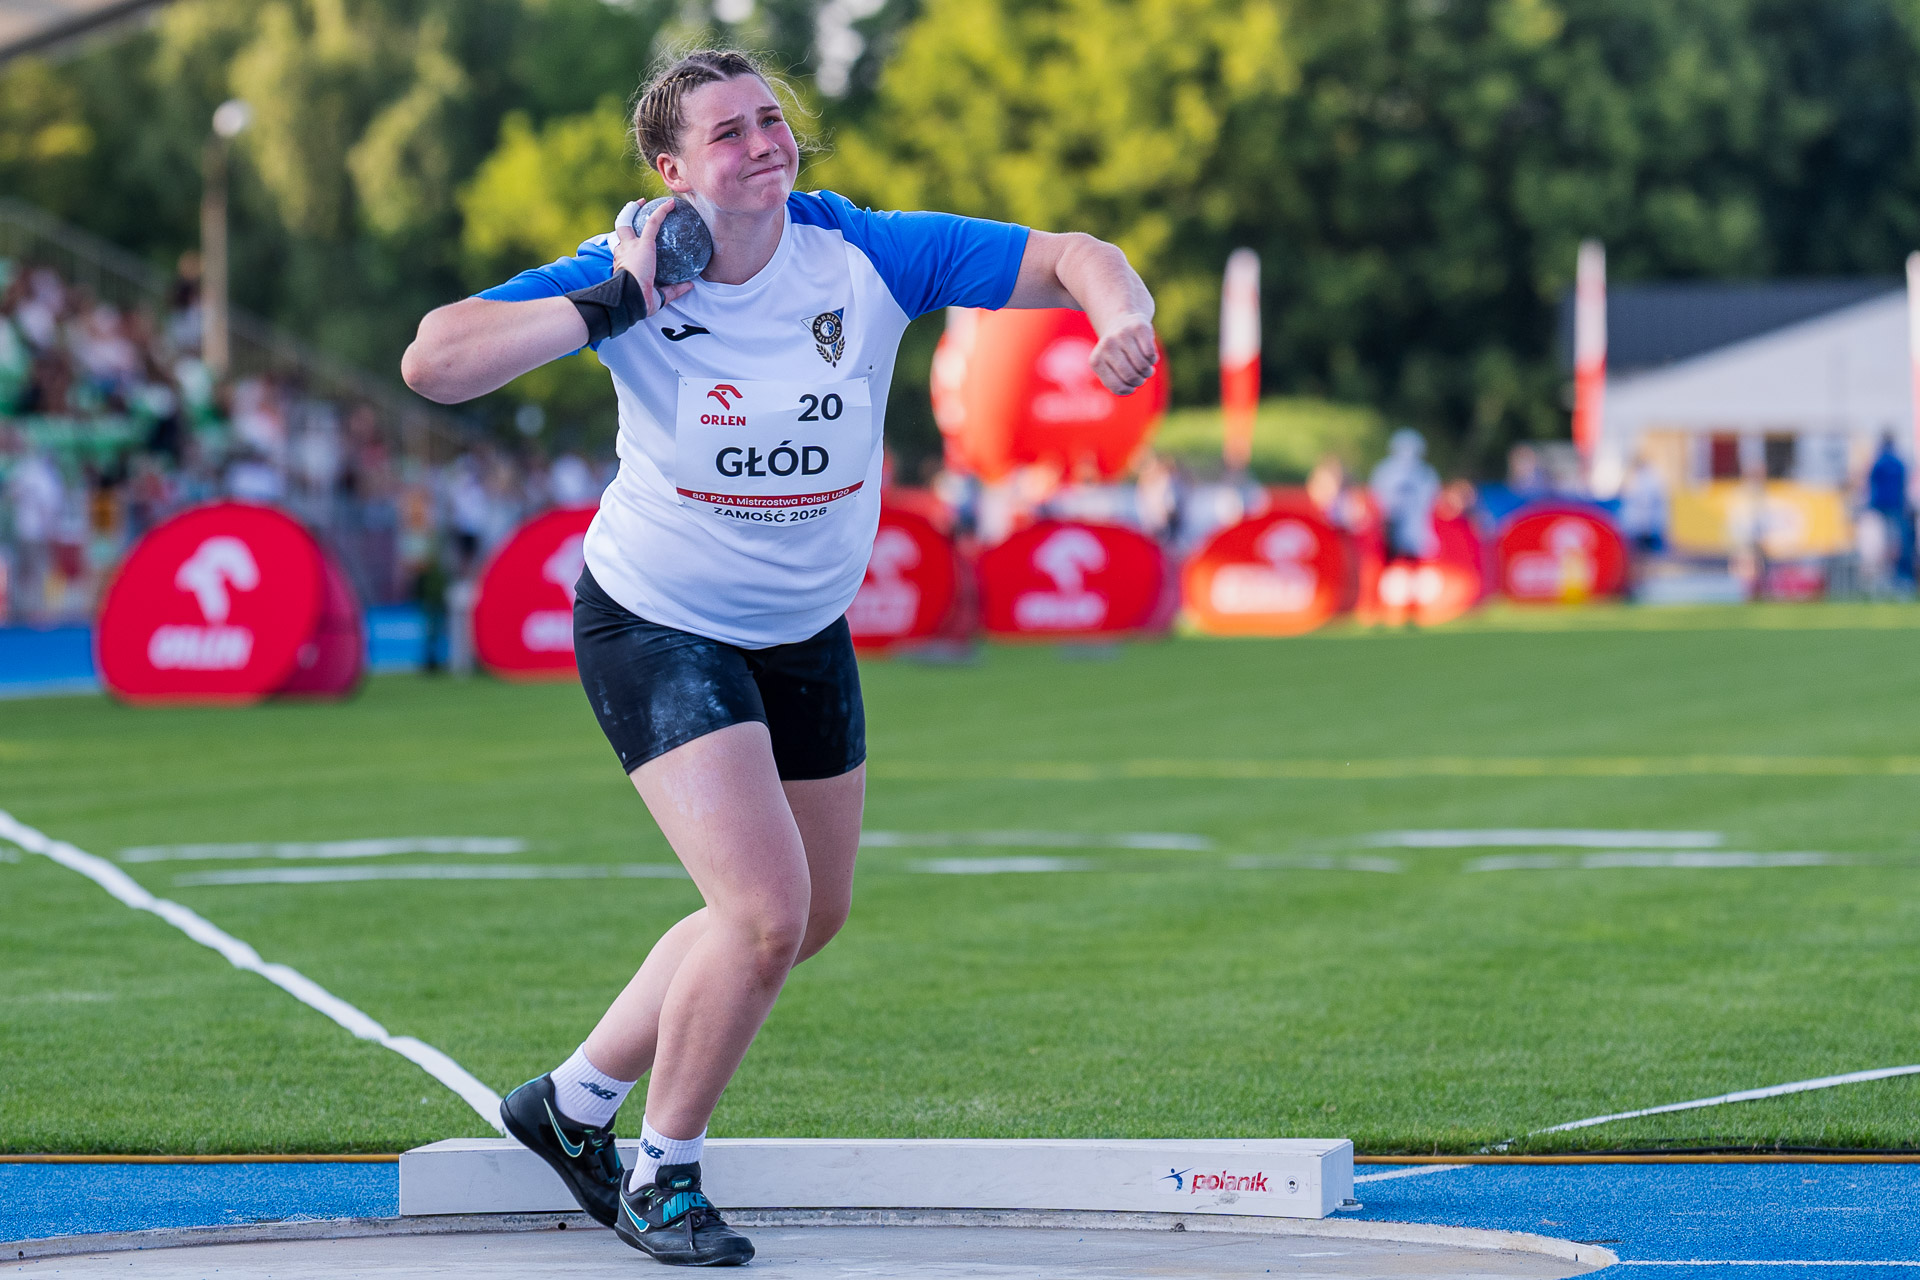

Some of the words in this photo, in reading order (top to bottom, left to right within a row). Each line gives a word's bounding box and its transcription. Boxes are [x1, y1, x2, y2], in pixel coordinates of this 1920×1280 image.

[700, 414, 746, 426] ORLEN
[797, 393, 843, 422] 20
[716, 440, 829, 477] GŁÓD
[710, 495, 734, 504] PZLA
[736, 498, 798, 506] Mistrzostwa
[800, 494, 830, 504] Polski
[831, 488, 850, 499] U20
[713, 506, 786, 523] ZAMOŚĆ
[789, 506, 827, 522] 2026
[1190, 1170, 1269, 1195] polanik
[662, 1191, 708, 1223] NIKE
